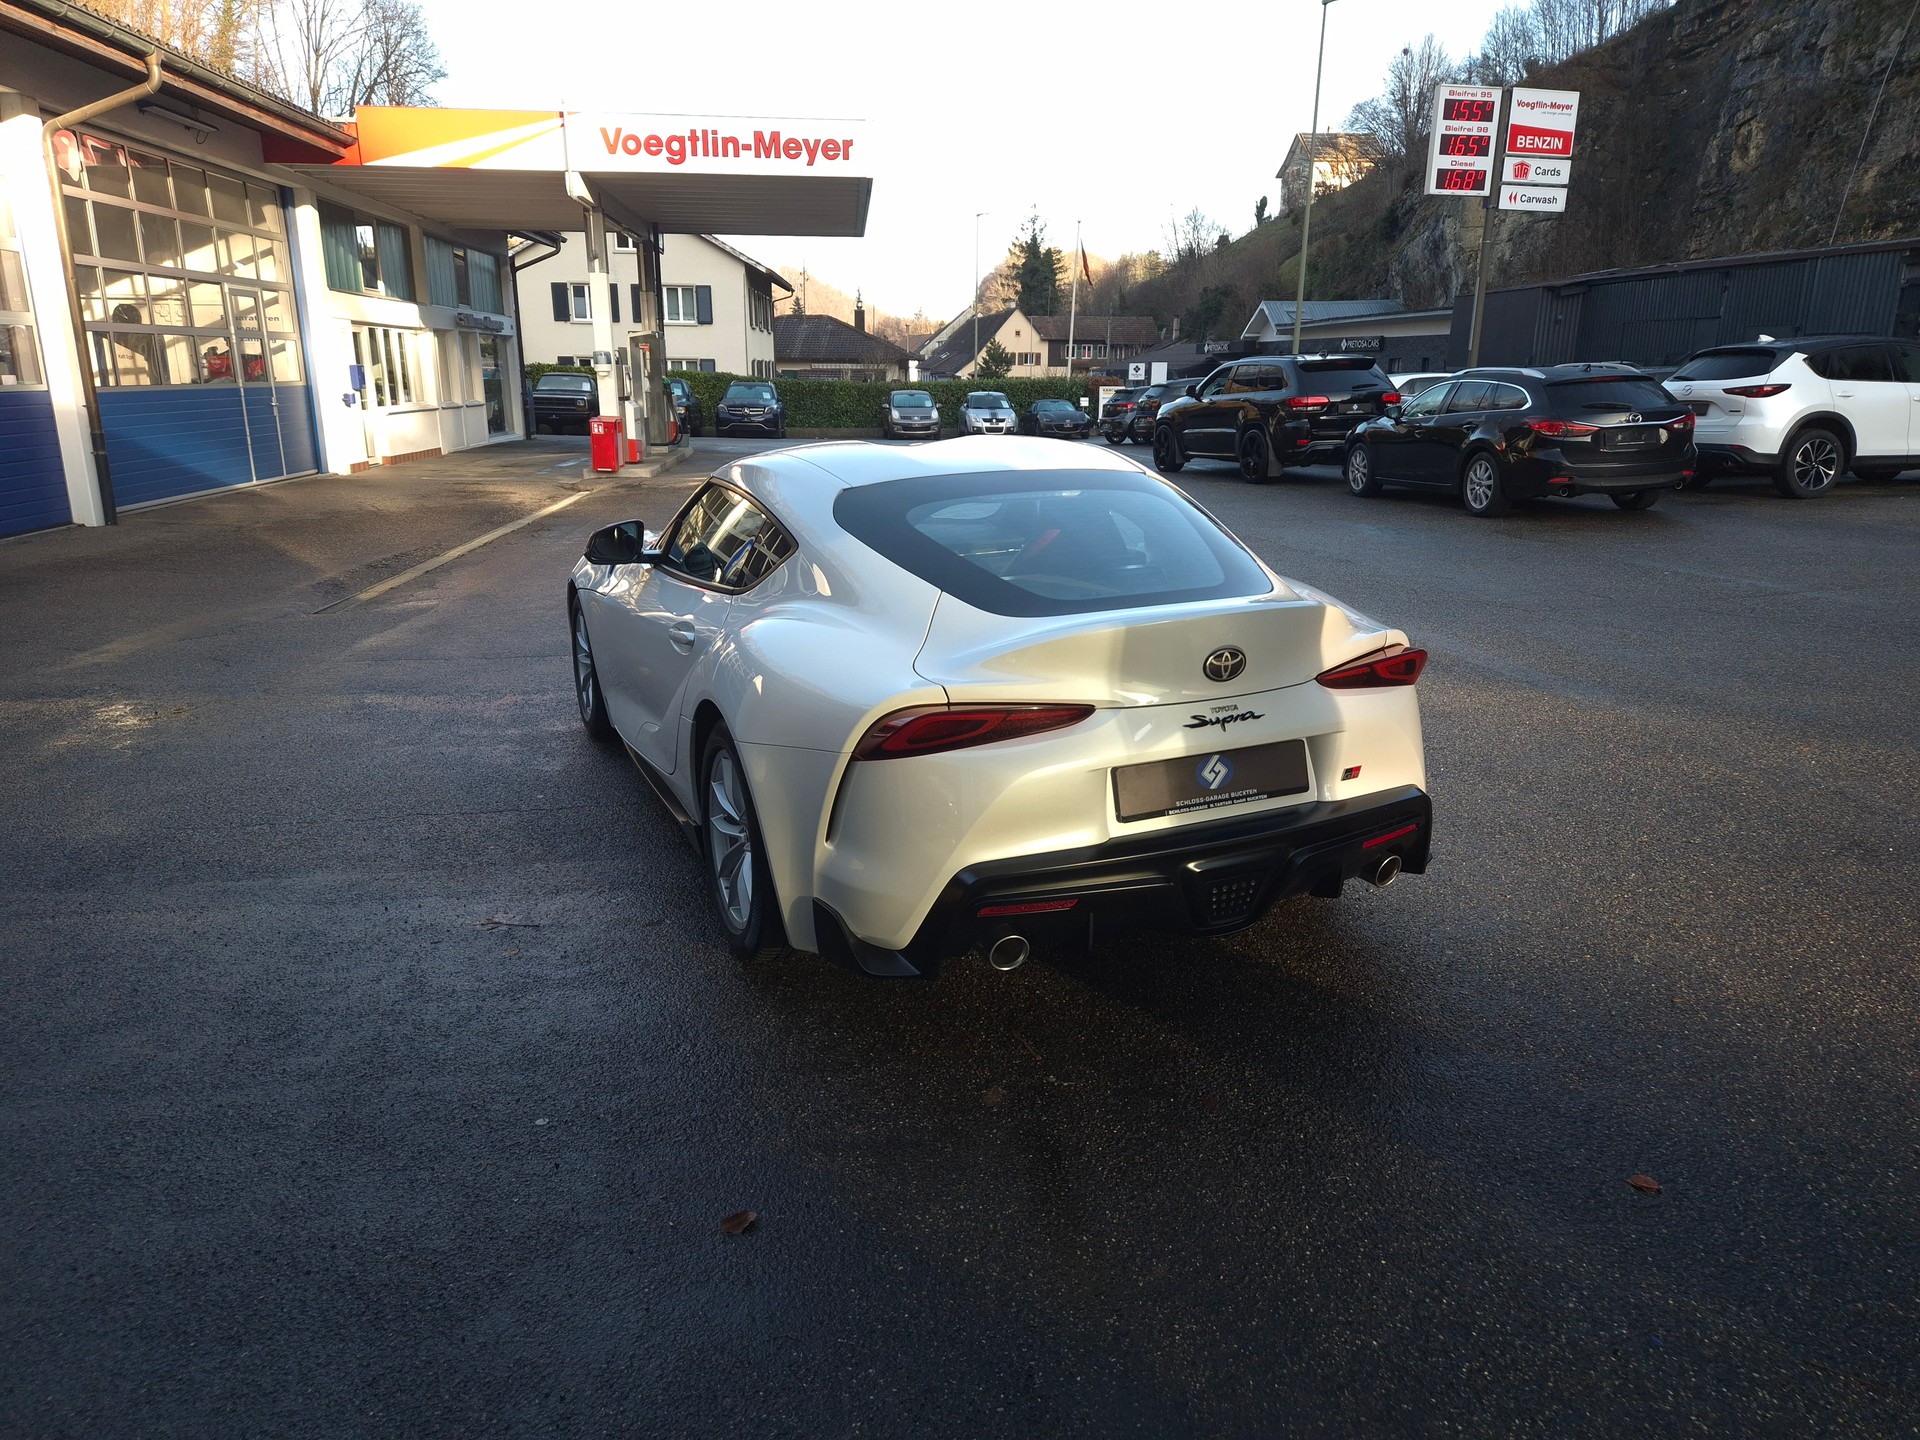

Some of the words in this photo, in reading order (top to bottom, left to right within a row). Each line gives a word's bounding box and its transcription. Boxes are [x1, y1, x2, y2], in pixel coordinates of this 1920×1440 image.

[1448, 89, 1478, 98] Bleifrei
[1480, 90, 1493, 98] 95
[1516, 99, 1573, 112] Voegtlin-Meyer
[1444, 125, 1474, 133] Bleifrei
[599, 127, 854, 166] Voegtlin-Meyer
[1516, 135, 1563, 150] BENZIN
[1534, 166, 1561, 177] Cards
[1519, 194, 1558, 205] Carwash
[1209, 704, 1239, 714] TOYOTA
[1182, 710, 1266, 732] Supra
[1176, 793, 1230, 807] SCHLOSS-GARAGE
[1230, 788, 1258, 798] BUCKTEN
[1168, 804, 1209, 815] SCHLOSS-GARAGE
